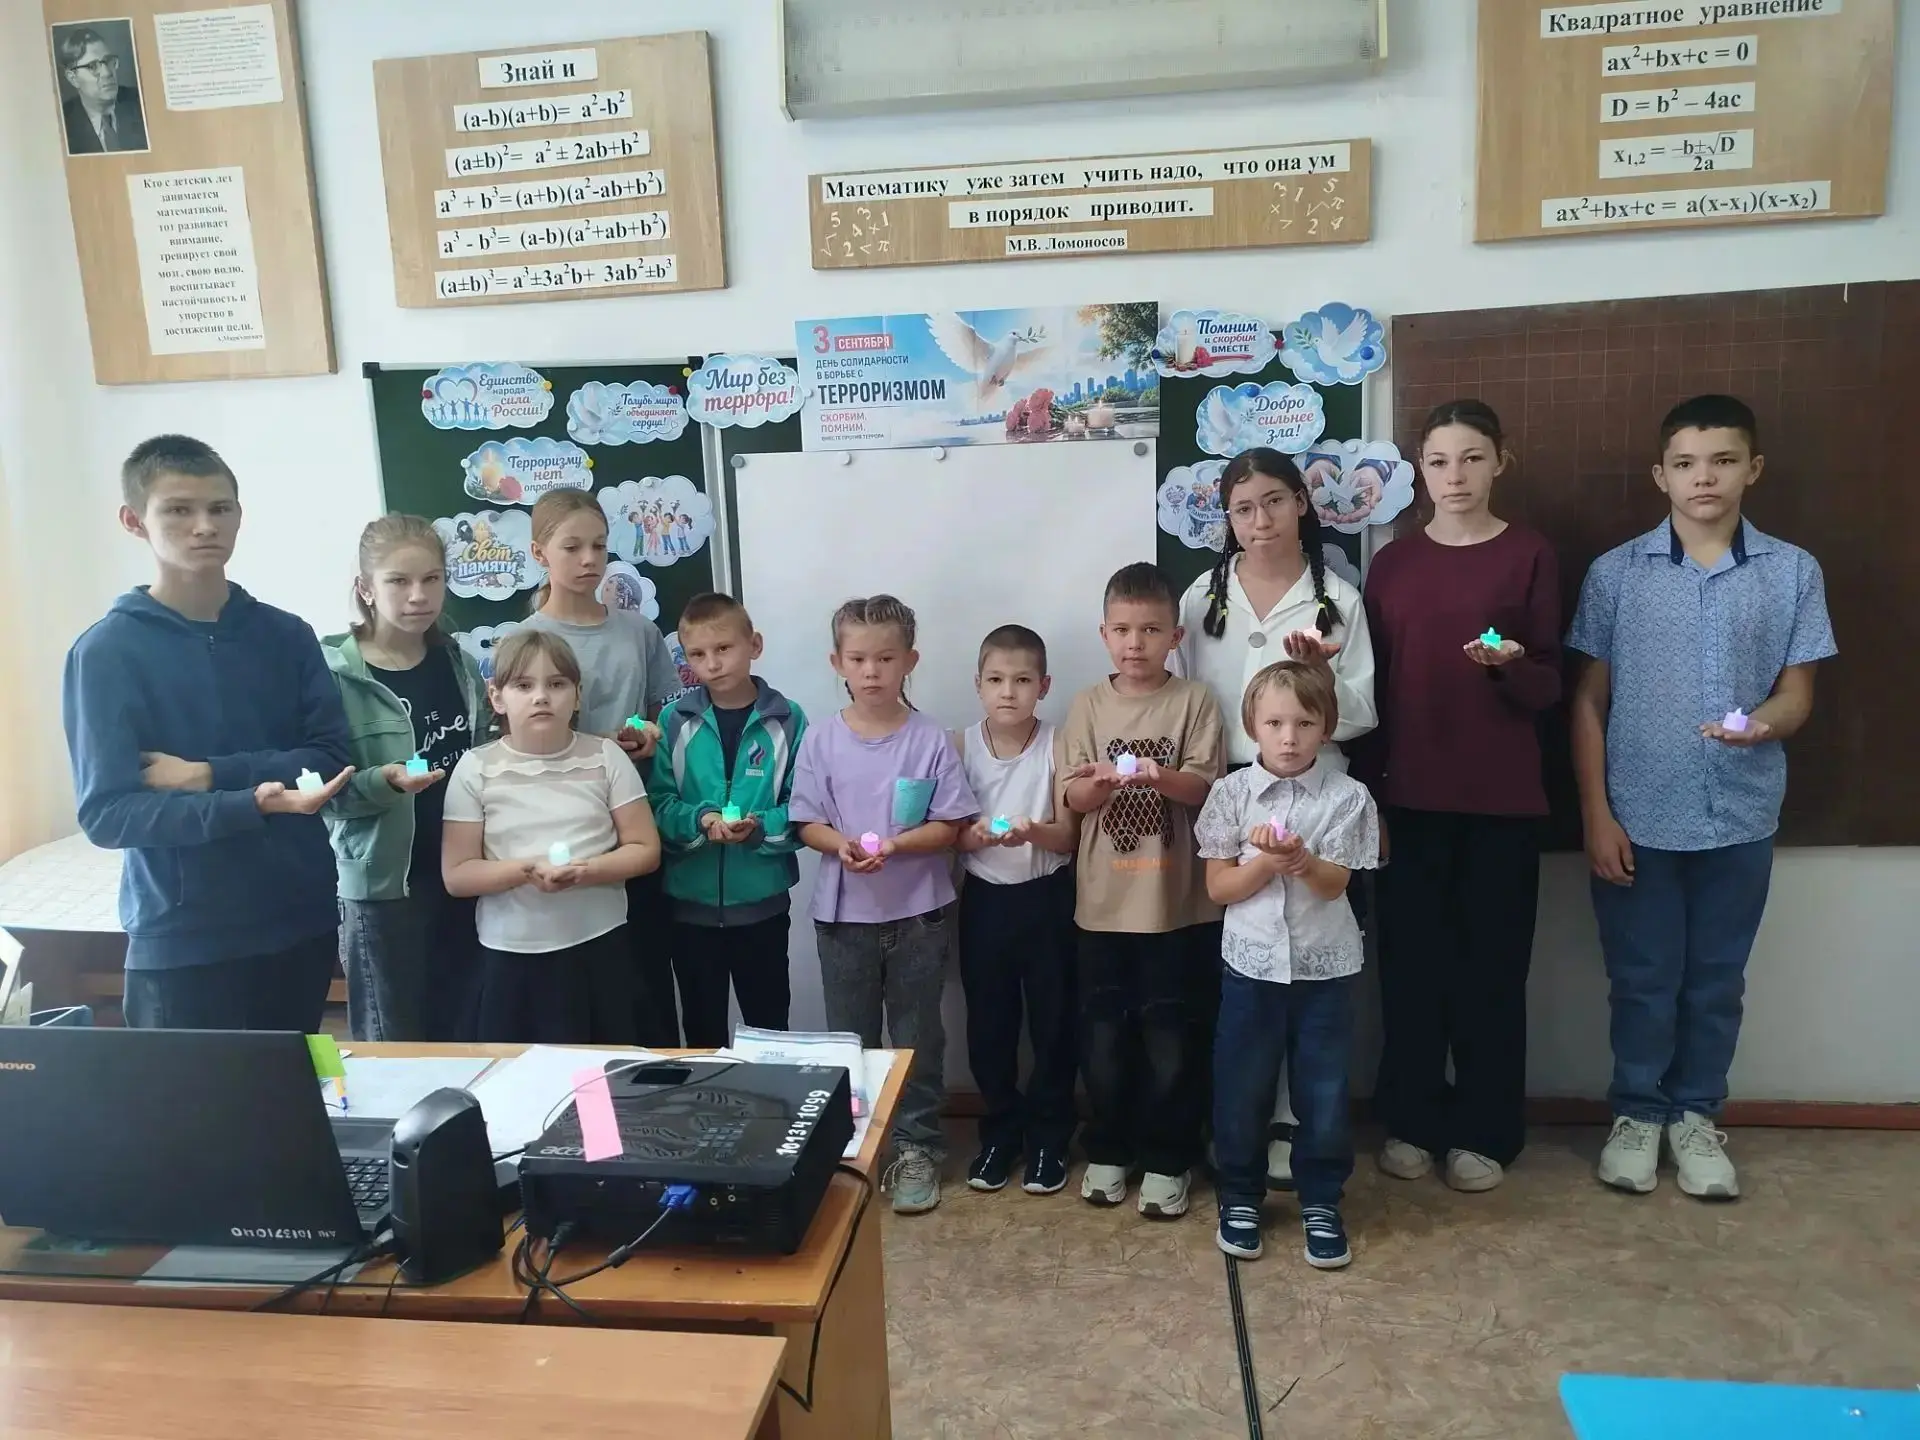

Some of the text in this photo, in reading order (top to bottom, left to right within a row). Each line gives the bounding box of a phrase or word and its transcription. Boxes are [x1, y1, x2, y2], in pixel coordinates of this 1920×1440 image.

[1549, 0, 1824, 33] Квадратное уравнение
[1736, 42, 1750, 61] 0
[500, 58, 576, 83] Знай и
[1612, 98, 1628, 116] D
[1704, 90, 1741, 110] 4ac
[143, 175, 233, 189] Кто с детских лет
[825, 151, 1336, 199] Математику уже затем учить надо, что она ум
[161, 191, 219, 203] занимается
[968, 197, 1194, 226] в порядок приводит.
[159, 220, 229, 233] тот развивает
[1008, 231, 1126, 252] М.В. Ломоносов
[160, 248, 237, 263] тренирует свой
[186, 267, 211, 277] свою
[169, 280, 236, 293] воспитывает
[160, 294, 247, 308] настойчивость и
[178, 311, 225, 323] упорство
[163, 323, 254, 338] достижении цели.
[1197, 319, 1258, 335] Помним
[813, 325, 890, 354] 3 СЕНТЯБРЯ
[1204, 333, 1257, 346] и скорбим
[1211, 344, 1250, 354] ВМЕСТЕ
[816, 355, 908, 370] ДЕНЬ СОЛИДАРНОСТИ
[479, 373, 539, 391] Единство
[705, 366, 786, 393] Мир без
[816, 369, 863, 380] В БОРЬБЕ С
[493, 387, 526, 396] народа
[818, 379, 946, 405] ТЕРРОРИЗМОМ
[501, 395, 531, 405] сила
[621, 393, 678, 408] Голубь мира
[704, 385, 795, 415] террора!
[1254, 395, 1305, 413] Добро
[491, 402, 543, 418] России!
[626, 406, 677, 419] объединяет
[632, 416, 667, 430] сердца!
[1257, 412, 1314, 426] сильнее
[1266, 425, 1301, 445] зла!
[508, 455, 583, 472] Терроризму
[533, 469, 563, 482] нет
[462, 539, 514, 561] Свет
[457, 560, 517, 578] памяти
